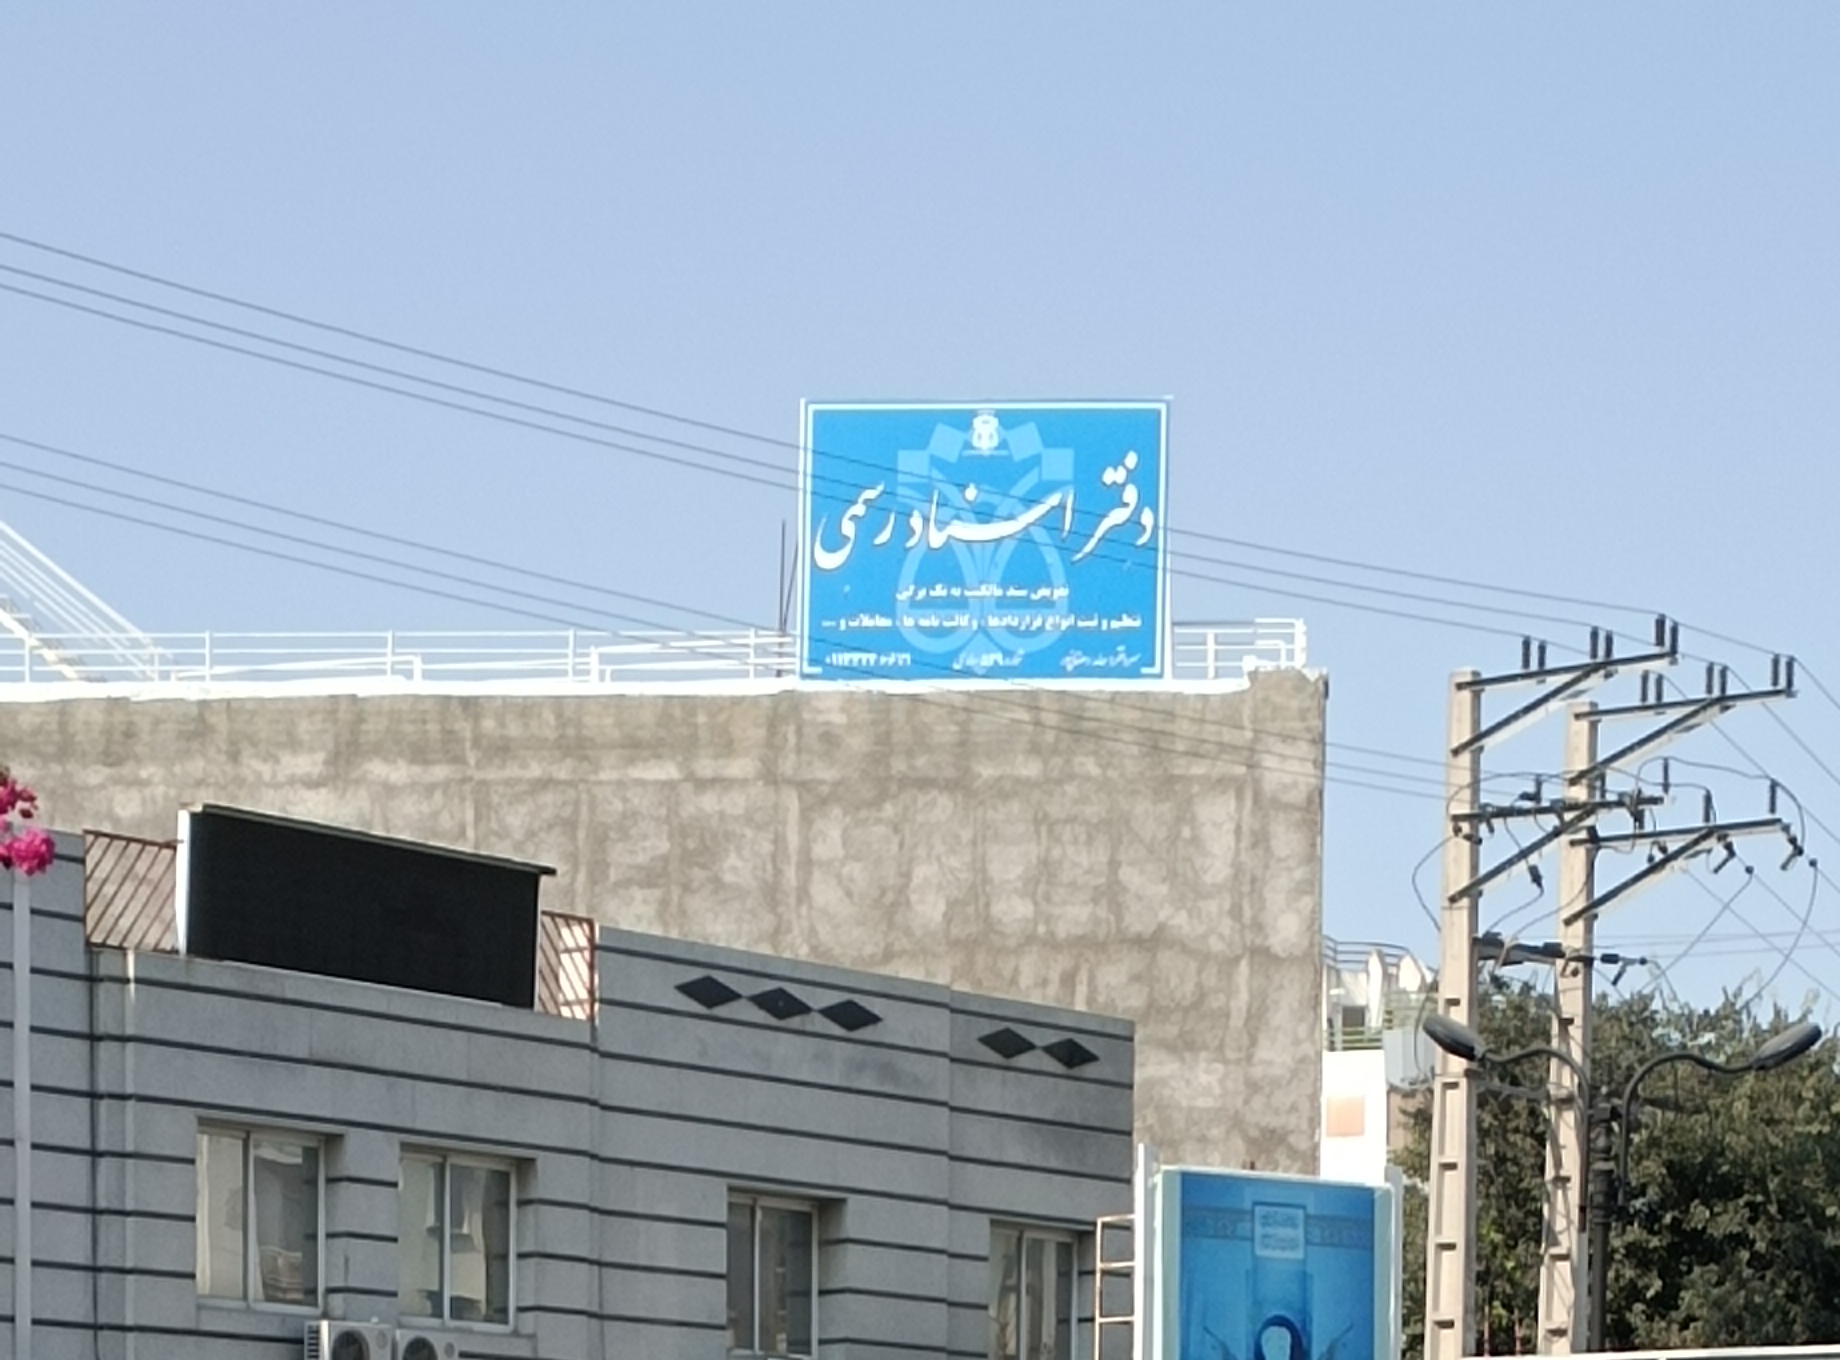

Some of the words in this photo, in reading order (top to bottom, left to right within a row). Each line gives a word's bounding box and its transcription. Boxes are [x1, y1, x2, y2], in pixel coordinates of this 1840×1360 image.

[813, 481, 896, 571] رسمی
[904, 483, 1075, 549] اسناد
[1070, 449, 1154, 565] دفتر
